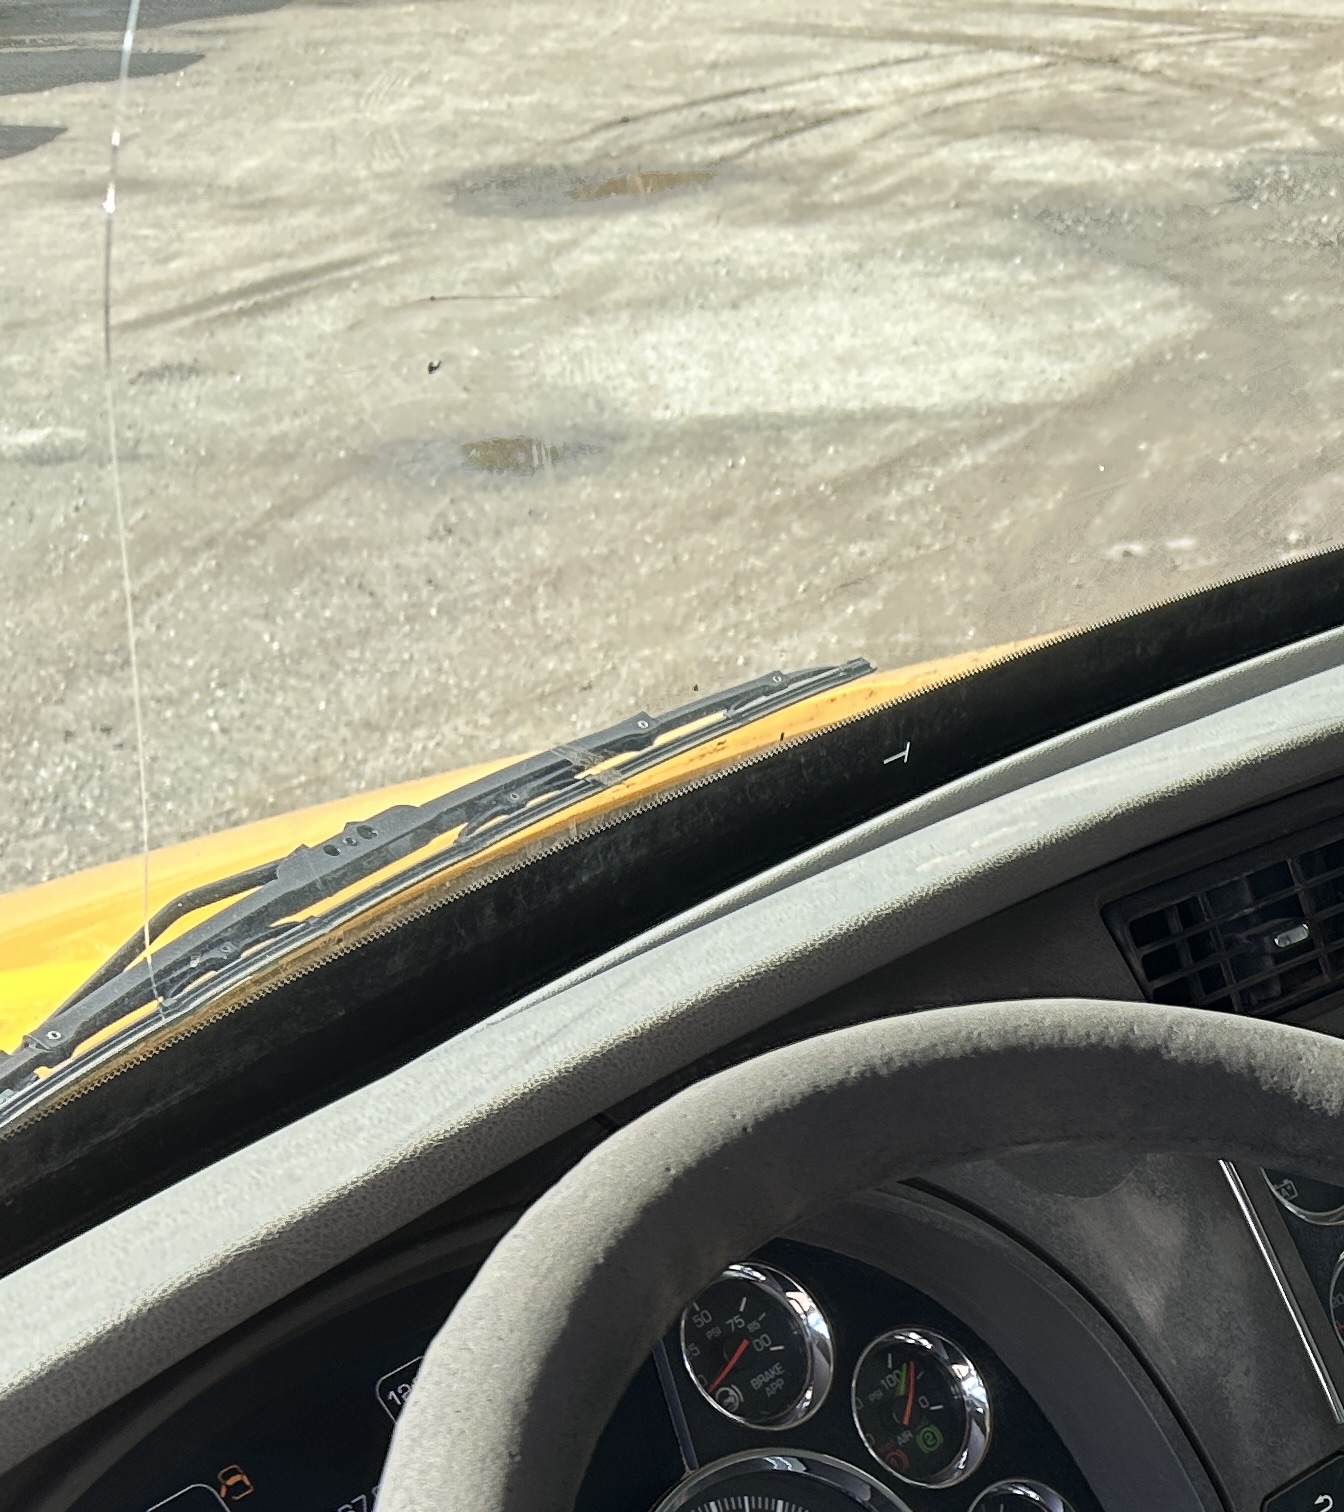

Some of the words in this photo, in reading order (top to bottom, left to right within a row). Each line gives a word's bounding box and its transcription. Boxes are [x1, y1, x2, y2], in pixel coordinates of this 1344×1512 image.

[691, 1309, 713, 1329] 50
[725, 1314, 746, 1333] 75
[705, 1326, 722, 1341] PSI
[750, 1362, 786, 1391] BRAKE
[880, 1369, 903, 1390] 100
[764, 1378, 785, 1398] APP
[897, 1429, 914, 1446] AIR
